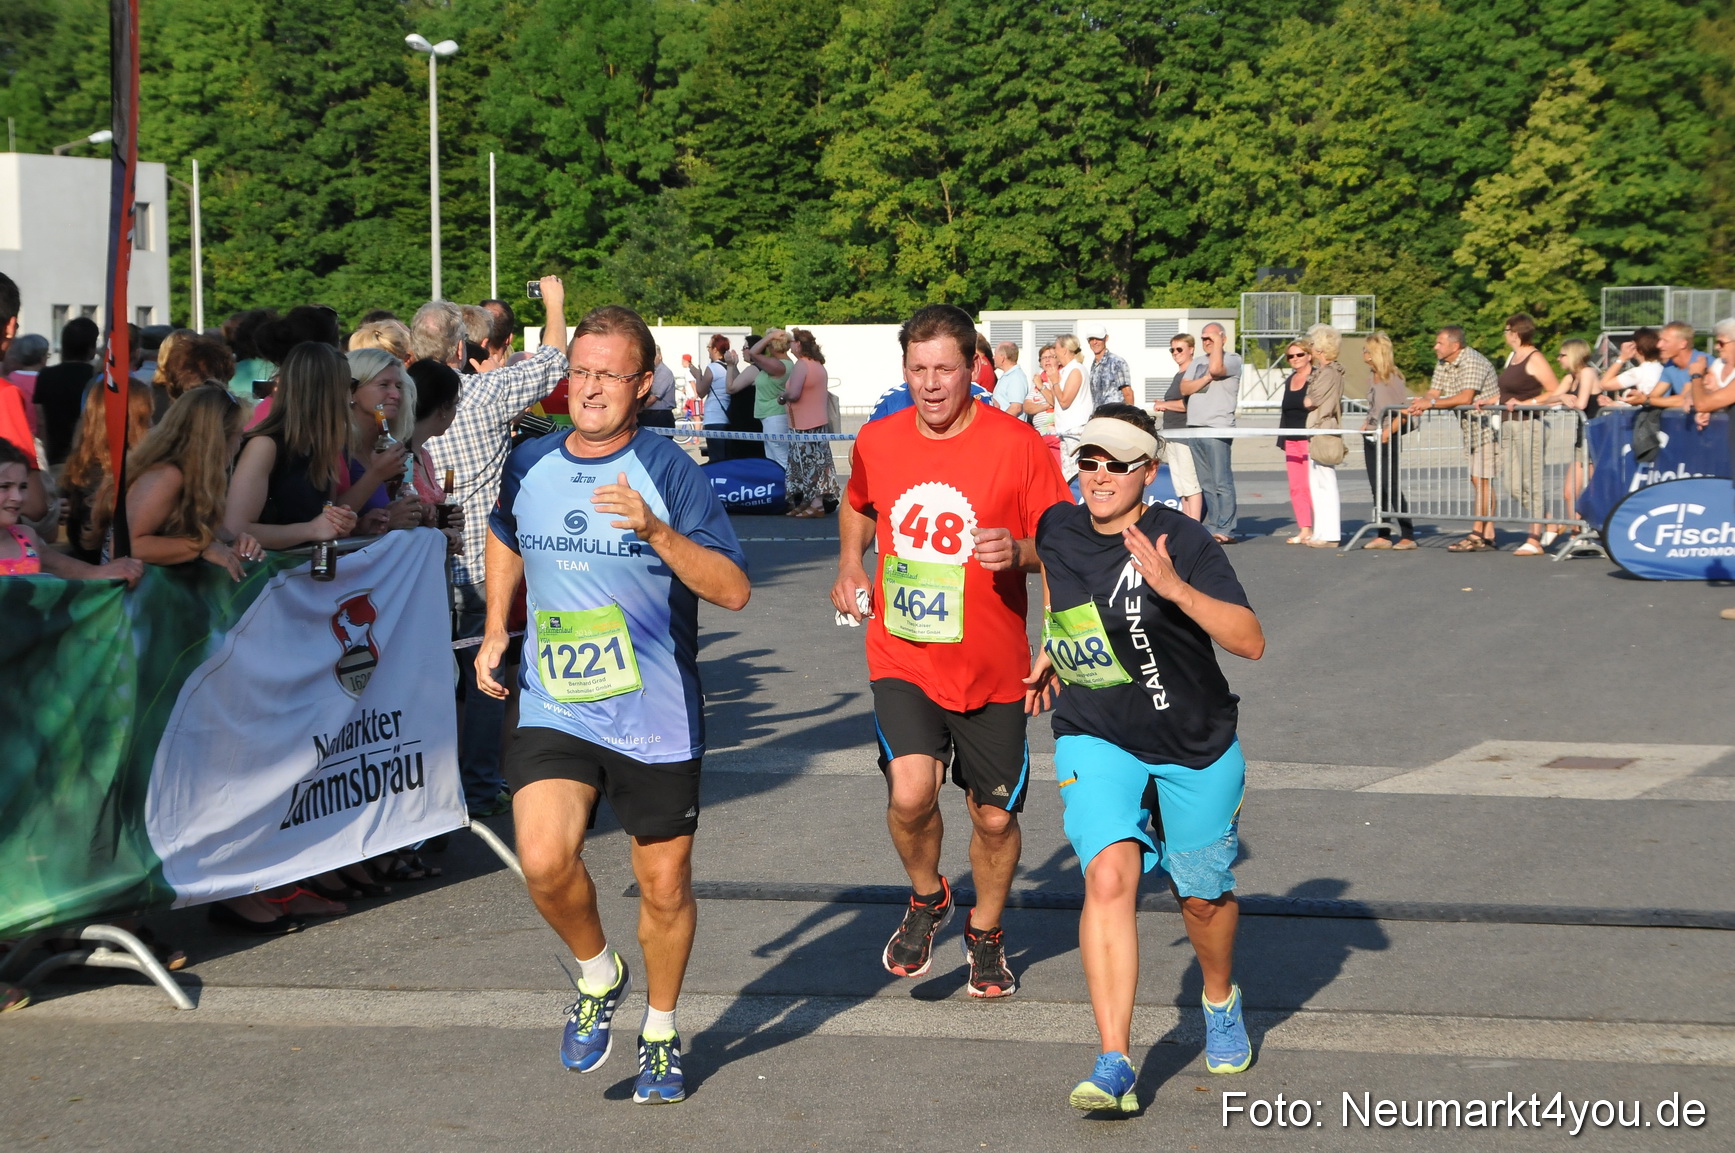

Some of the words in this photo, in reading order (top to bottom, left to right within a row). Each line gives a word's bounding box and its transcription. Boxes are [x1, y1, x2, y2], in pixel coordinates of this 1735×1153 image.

[1629, 462, 1715, 492] Fisch
[520, 533, 642, 558] SCHABMÜLLER
[1655, 521, 1735, 546] Fisch
[556, 560, 590, 572] TEAM
[893, 586, 948, 622] 464
[541, 636, 626, 679] 1221
[1044, 636, 1113, 671] 1048
[1125, 595, 1170, 711] RAIL.ONE
[313, 708, 402, 770] Nmarkter
